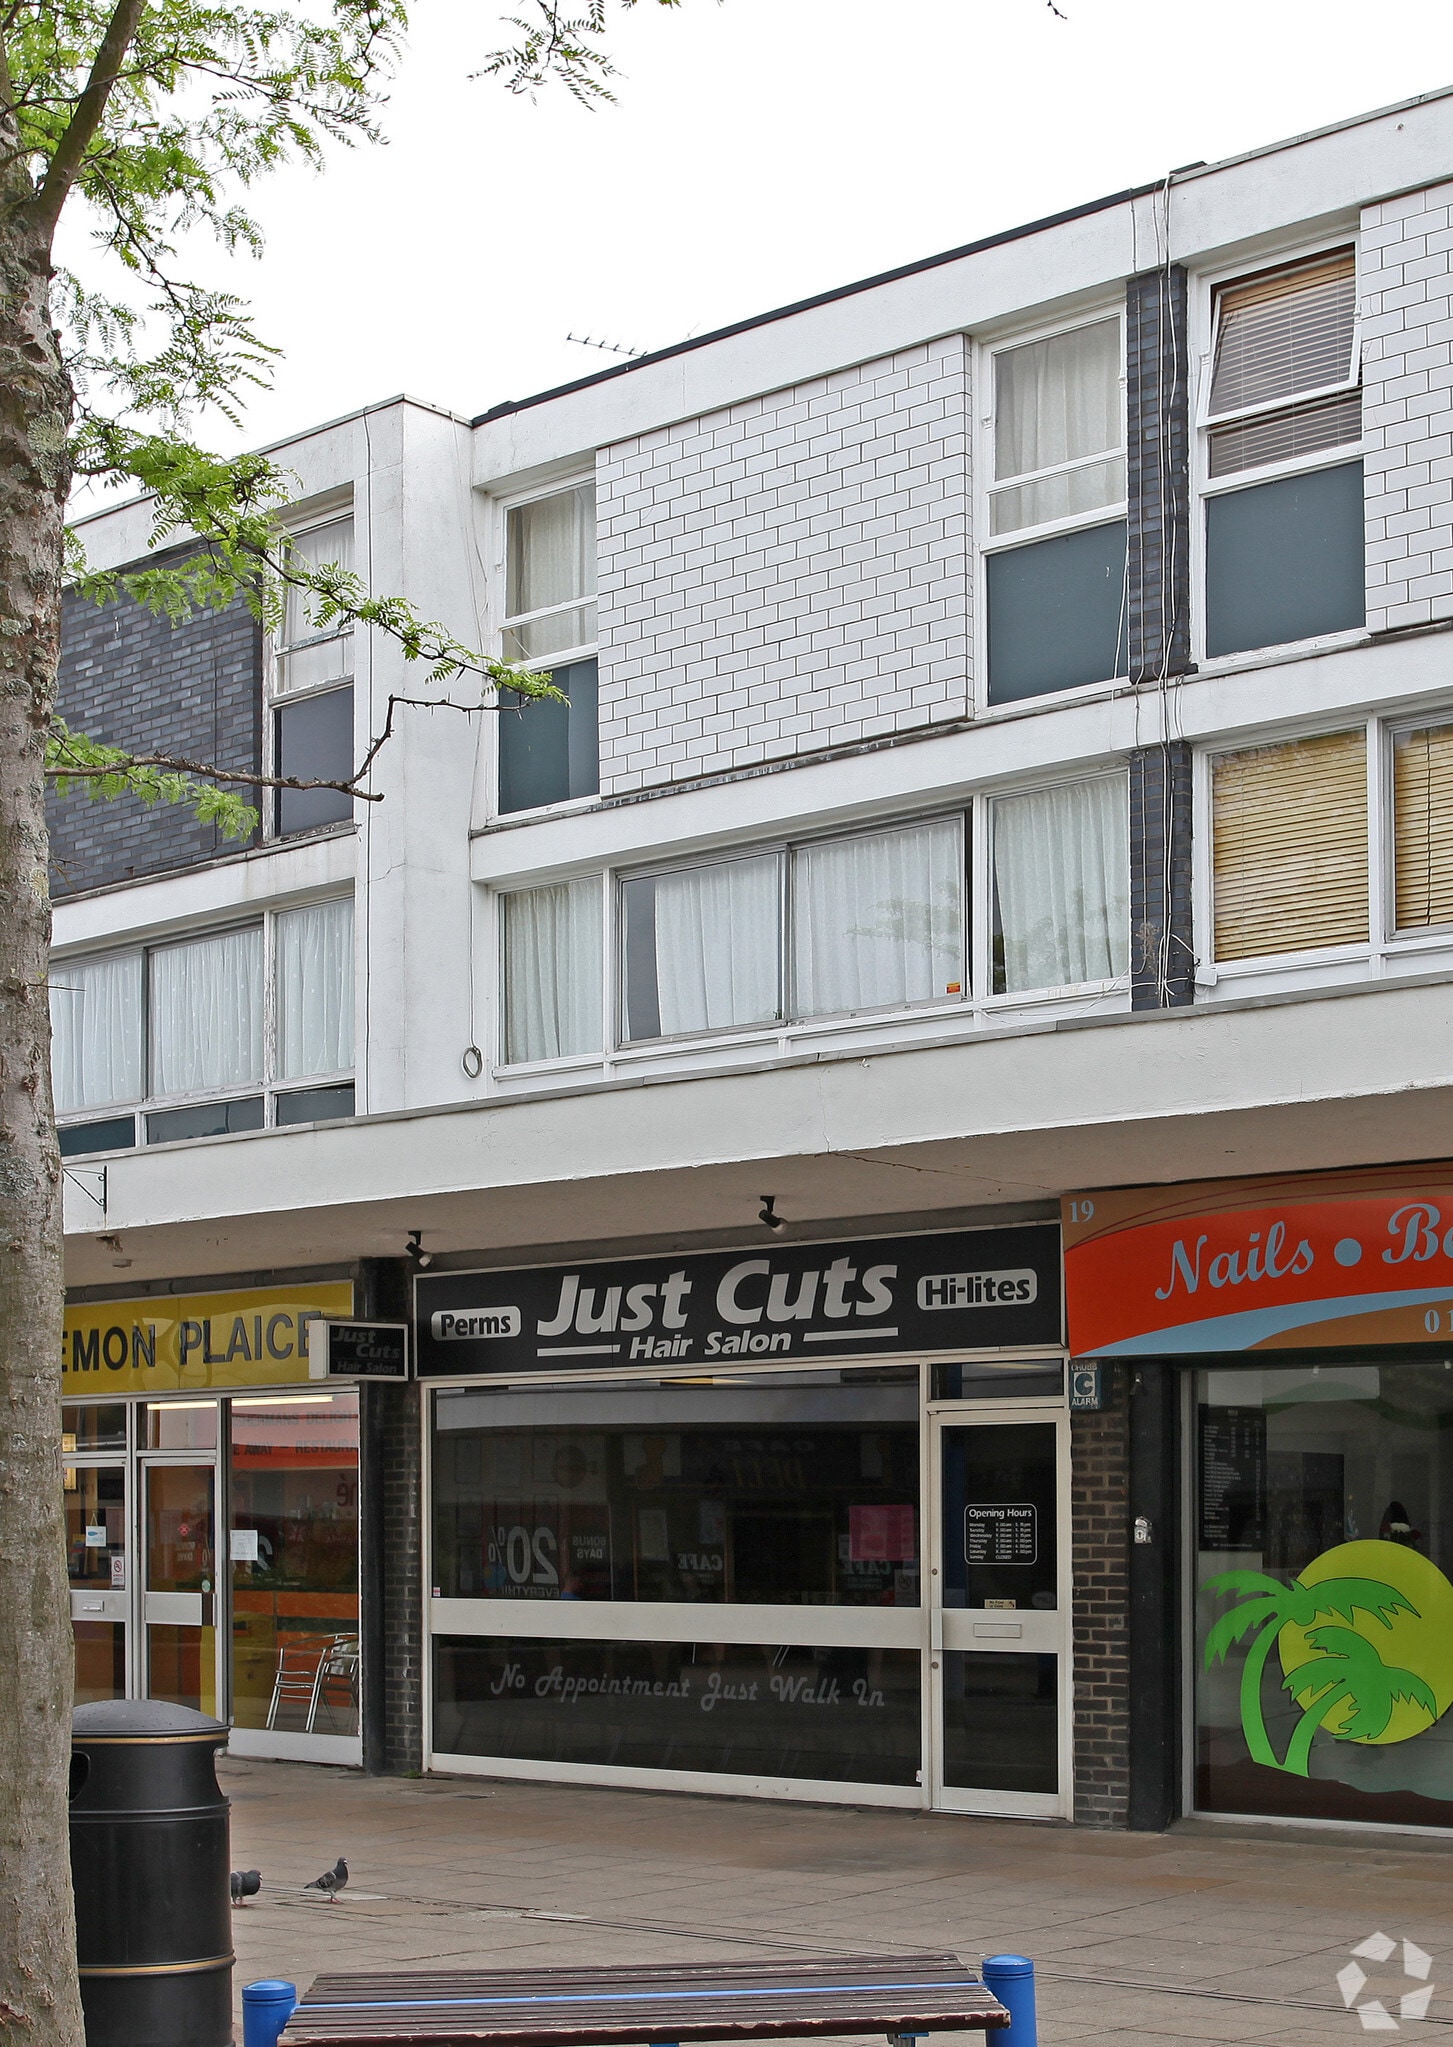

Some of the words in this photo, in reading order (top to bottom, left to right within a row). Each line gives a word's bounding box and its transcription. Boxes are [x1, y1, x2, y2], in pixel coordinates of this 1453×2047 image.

[1069, 1199, 1094, 1223] 19
[1154, 1220, 1315, 1300] Nails
[536, 1270, 693, 1337] Just
[716, 1256, 898, 1324] Cuts
[925, 1275, 1031, 1306] Hi-lites
[333, 1327, 376, 1344] Just
[441, 1312, 511, 1337] Perms
[62, 1324, 156, 1373] MON
[179, 1311, 321, 1366] PLAICE
[356, 1343, 401, 1359] Cuts
[629, 1334, 694, 1360] Hair
[704, 1330, 792, 1355] Salon
[336, 1361, 362, 1372] Hair
[366, 1362, 397, 1374] Salon
[1072, 1397, 1098, 1407] ALARM
[968, 1508, 1004, 1520] Opening
[1007, 1508, 1032, 1517] Hours
[490, 1664, 525, 1695] No
[534, 1666, 690, 1704] Appointment
[700, 1672, 758, 1712] Just
[770, 1675, 840, 1704] Walk
[852, 1678, 885, 1707] In
